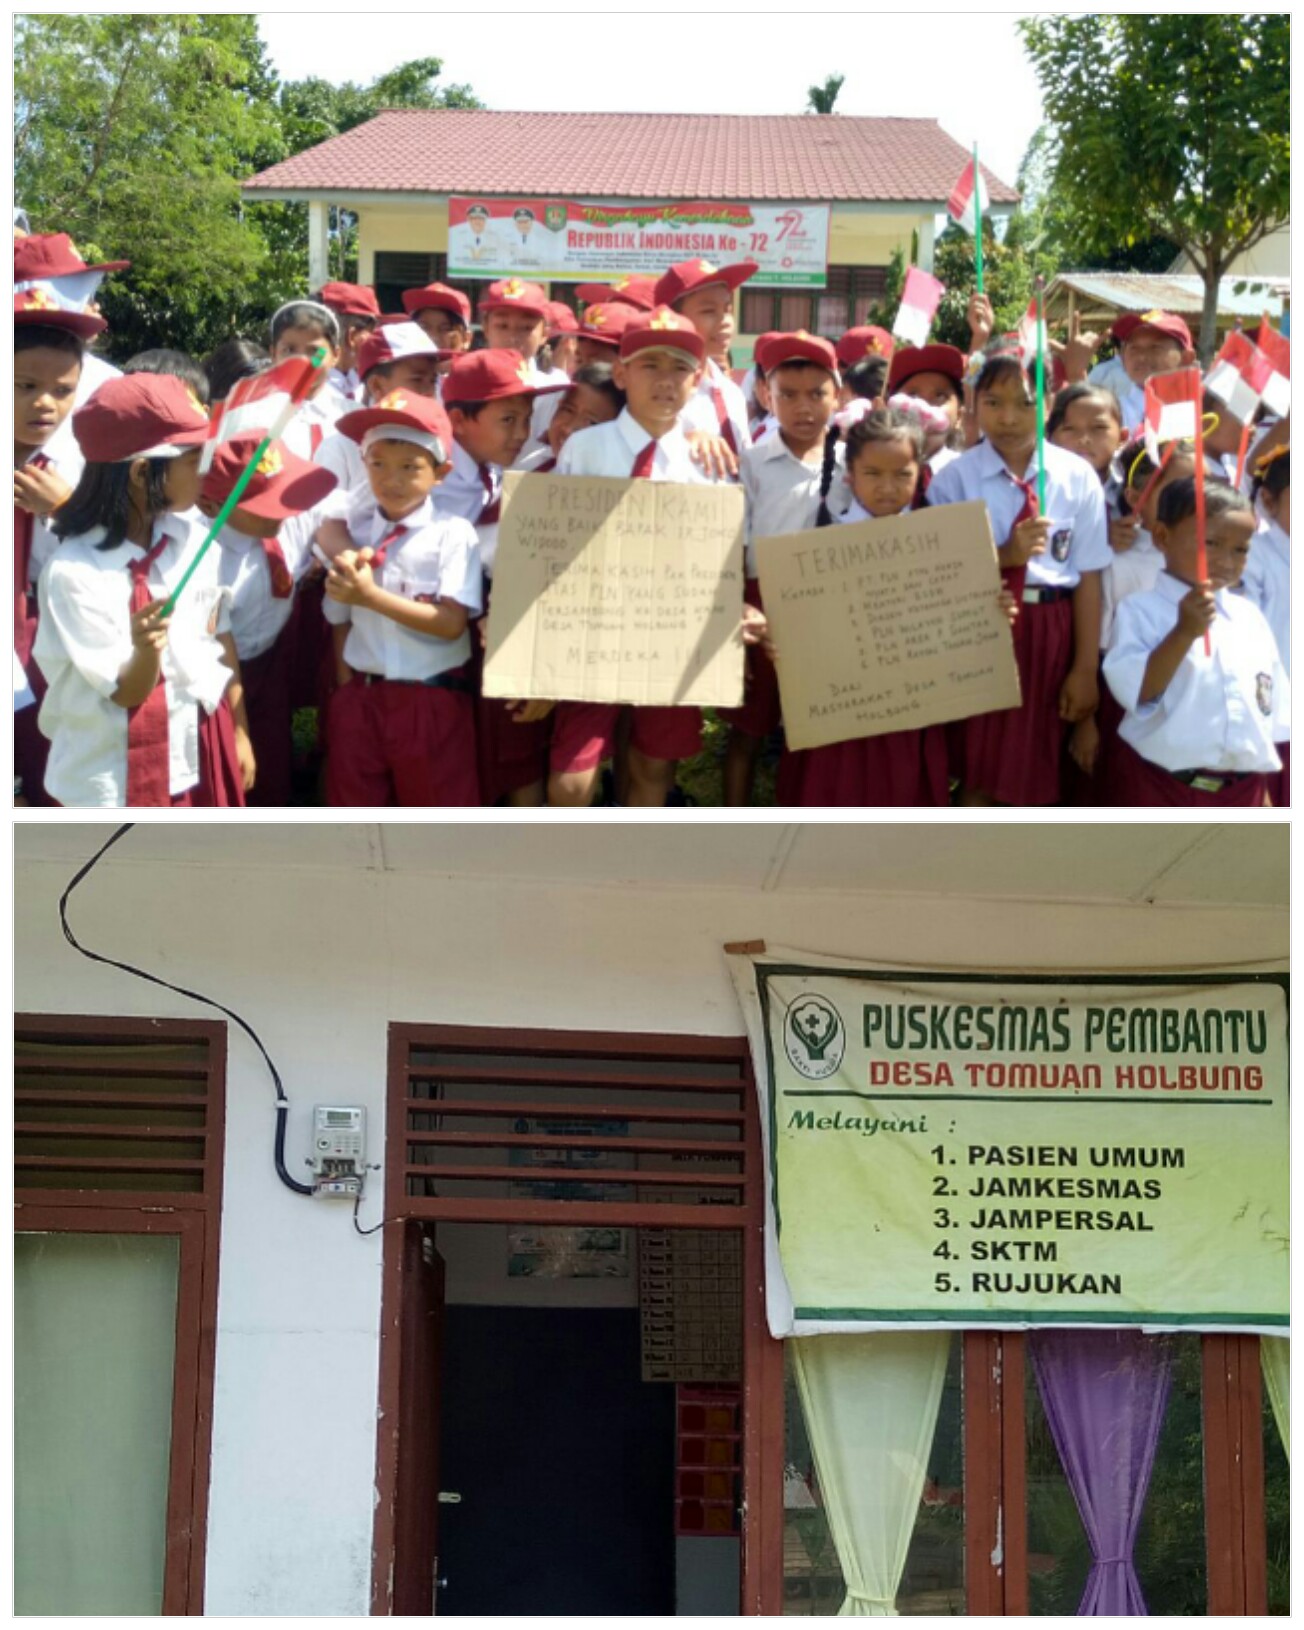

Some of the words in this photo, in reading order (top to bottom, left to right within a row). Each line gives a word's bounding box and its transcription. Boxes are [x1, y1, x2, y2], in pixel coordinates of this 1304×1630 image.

[639, 231, 715, 250] INDONESIA
[750, 232, 768, 251] 72
[546, 483, 646, 517] PRESIDEN
[661, 494, 718, 522] KAMI
[515, 513, 560, 533] YANG
[791, 531, 941, 579] TERIMAKASIH
[862, 1003, 1072, 1052] PUSKESMAS
[1084, 1007, 1268, 1055] PEMBANTU
[869, 1061, 955, 1088] DESA
[964, 1062, 1102, 1089] TOMUAN
[1114, 1064, 1264, 1091] HOLBUNG
[787, 1109, 928, 1137] Melayani
[930, 1144, 956, 1166] 1.
[968, 1145, 1078, 1167] PASIEN
[1089, 1147, 1186, 1169] UMUM
[932, 1175, 959, 1197] 2.
[968, 1176, 1162, 1200] JAMKESMAS
[933, 1207, 960, 1229] 3.
[969, 1208, 1155, 1232] JAMPERSAL
[932, 1239, 960, 1261] 4.
[970, 1240, 1058, 1262] SKTM
[934, 1272, 961, 1293] 5.
[972, 1272, 1122, 1295] RUJUKAN
